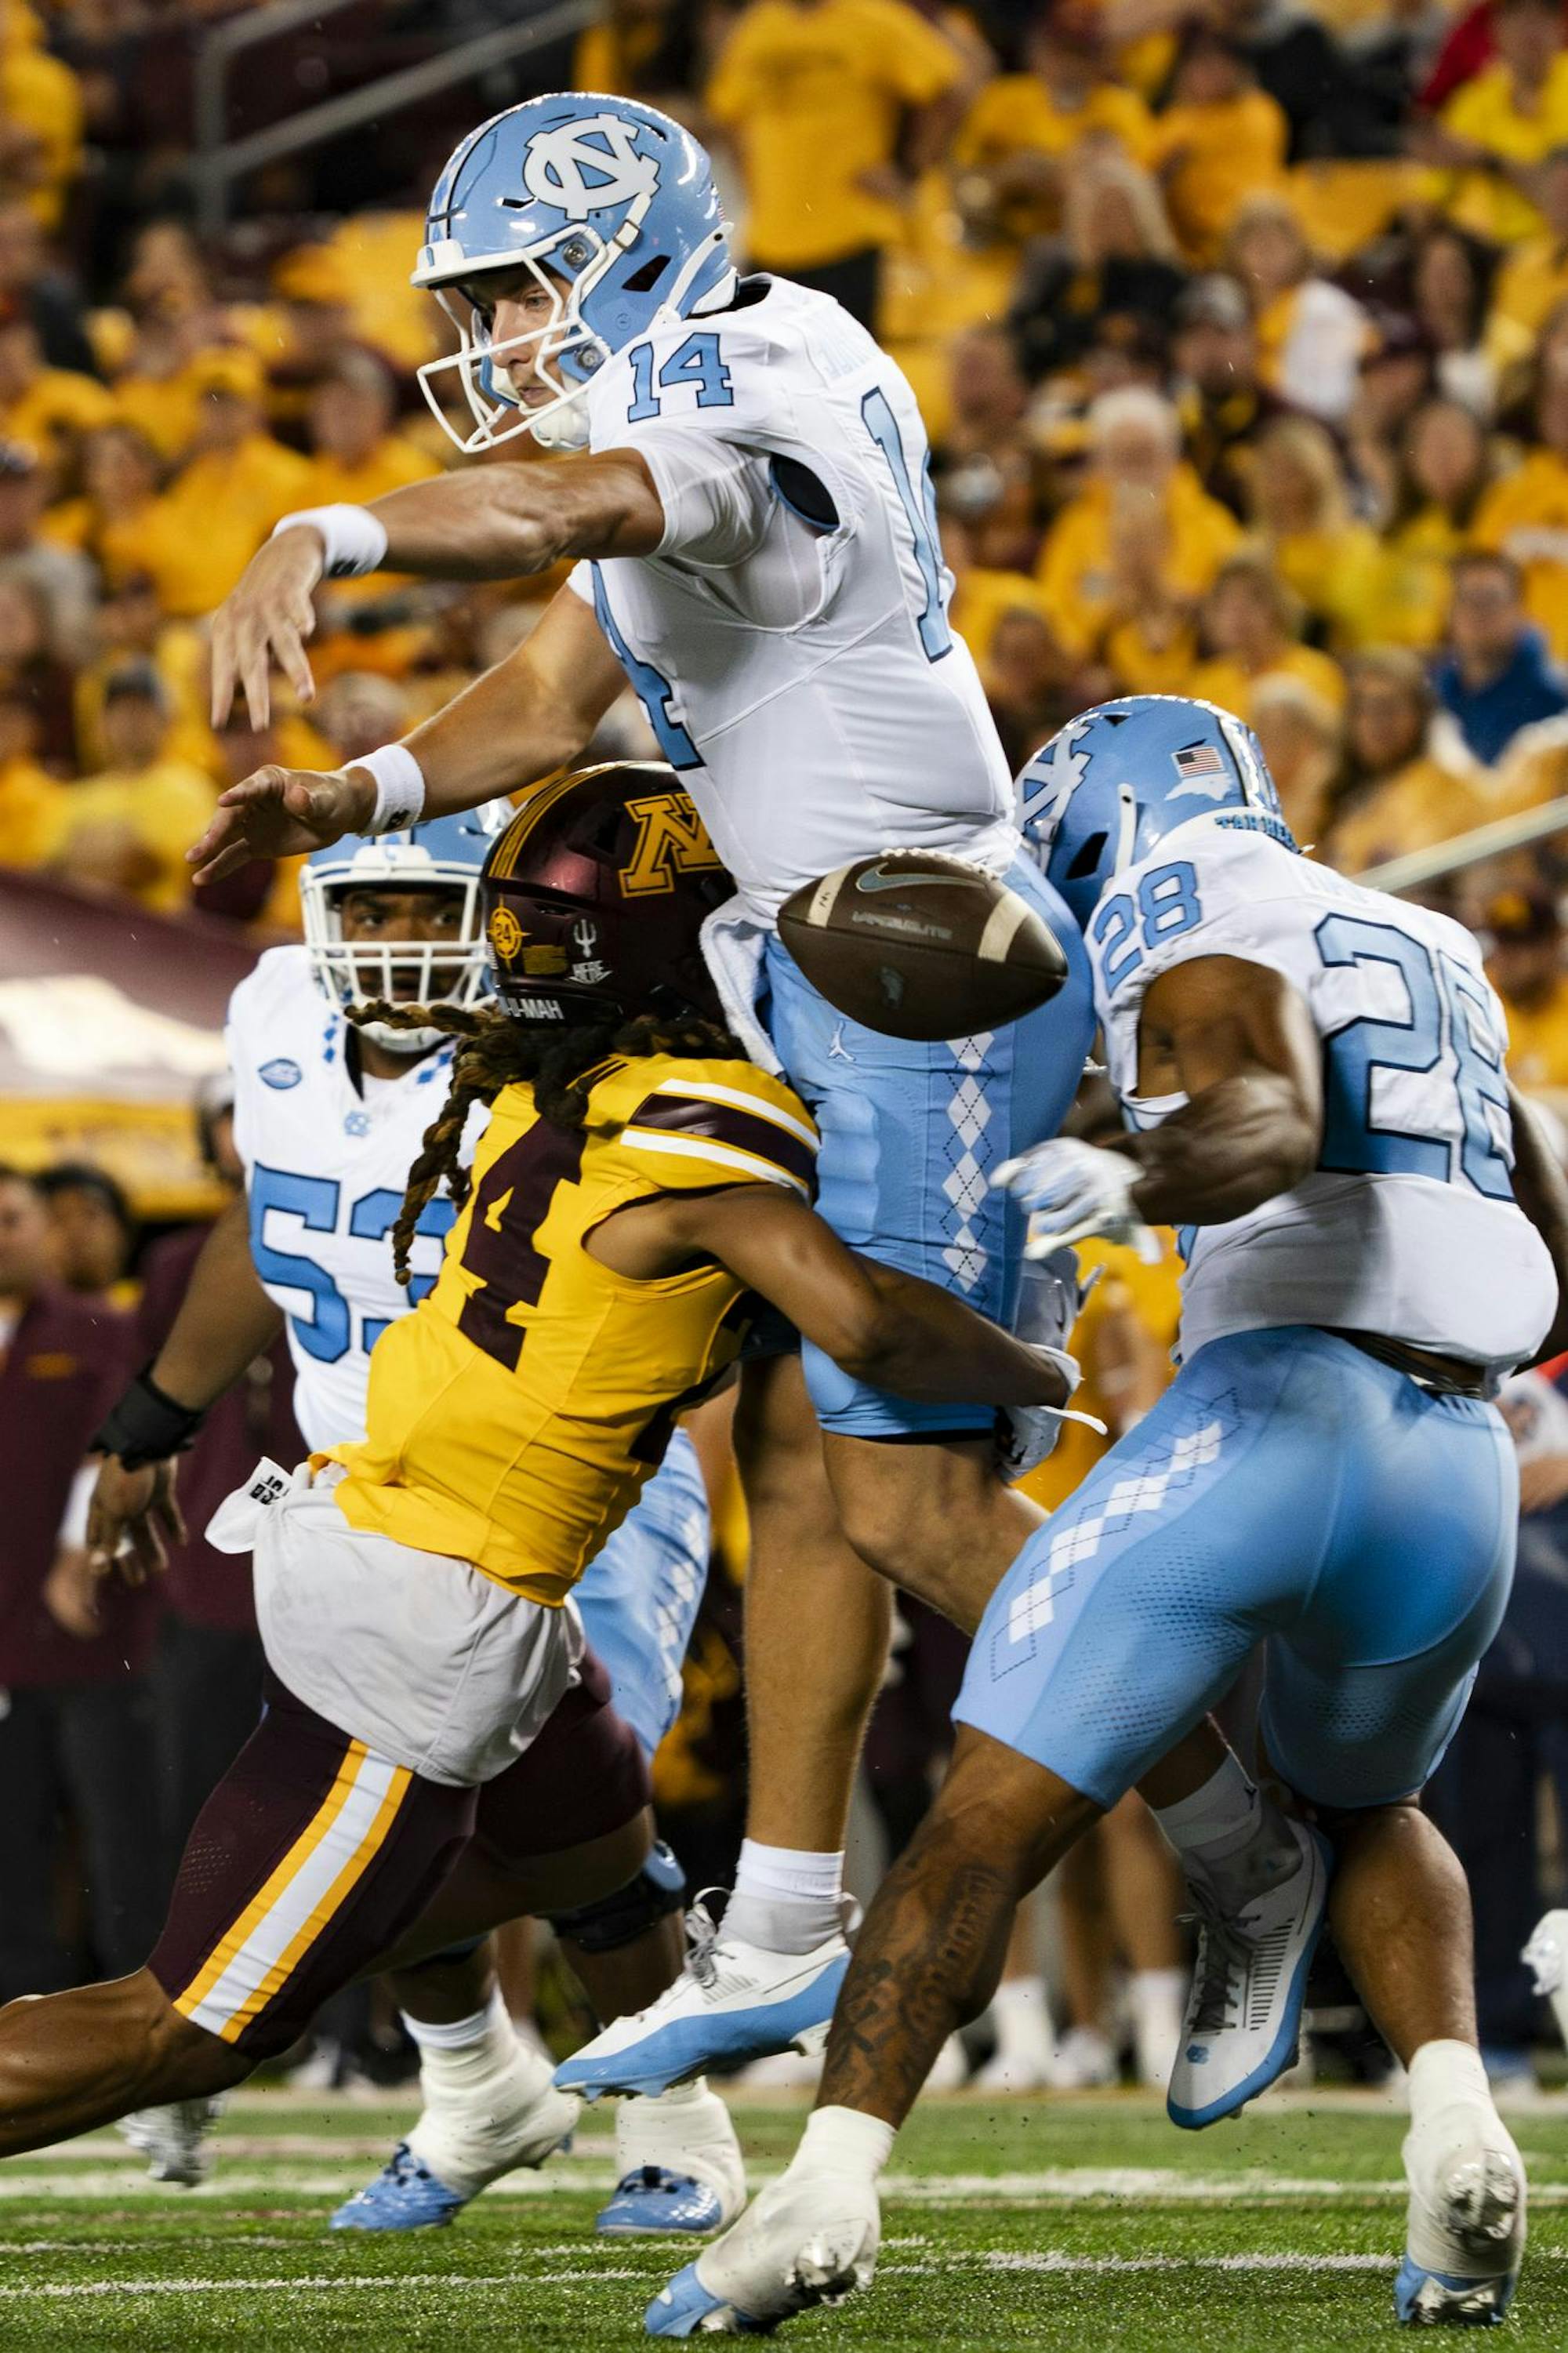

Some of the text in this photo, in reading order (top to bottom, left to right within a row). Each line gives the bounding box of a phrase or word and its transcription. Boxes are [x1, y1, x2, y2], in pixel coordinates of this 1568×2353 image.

[628, 332, 735, 423] 14
[1214, 813, 1258, 831] TAR
[1094, 860, 1203, 997] 28
[1315, 912, 1515, 1204] 28
